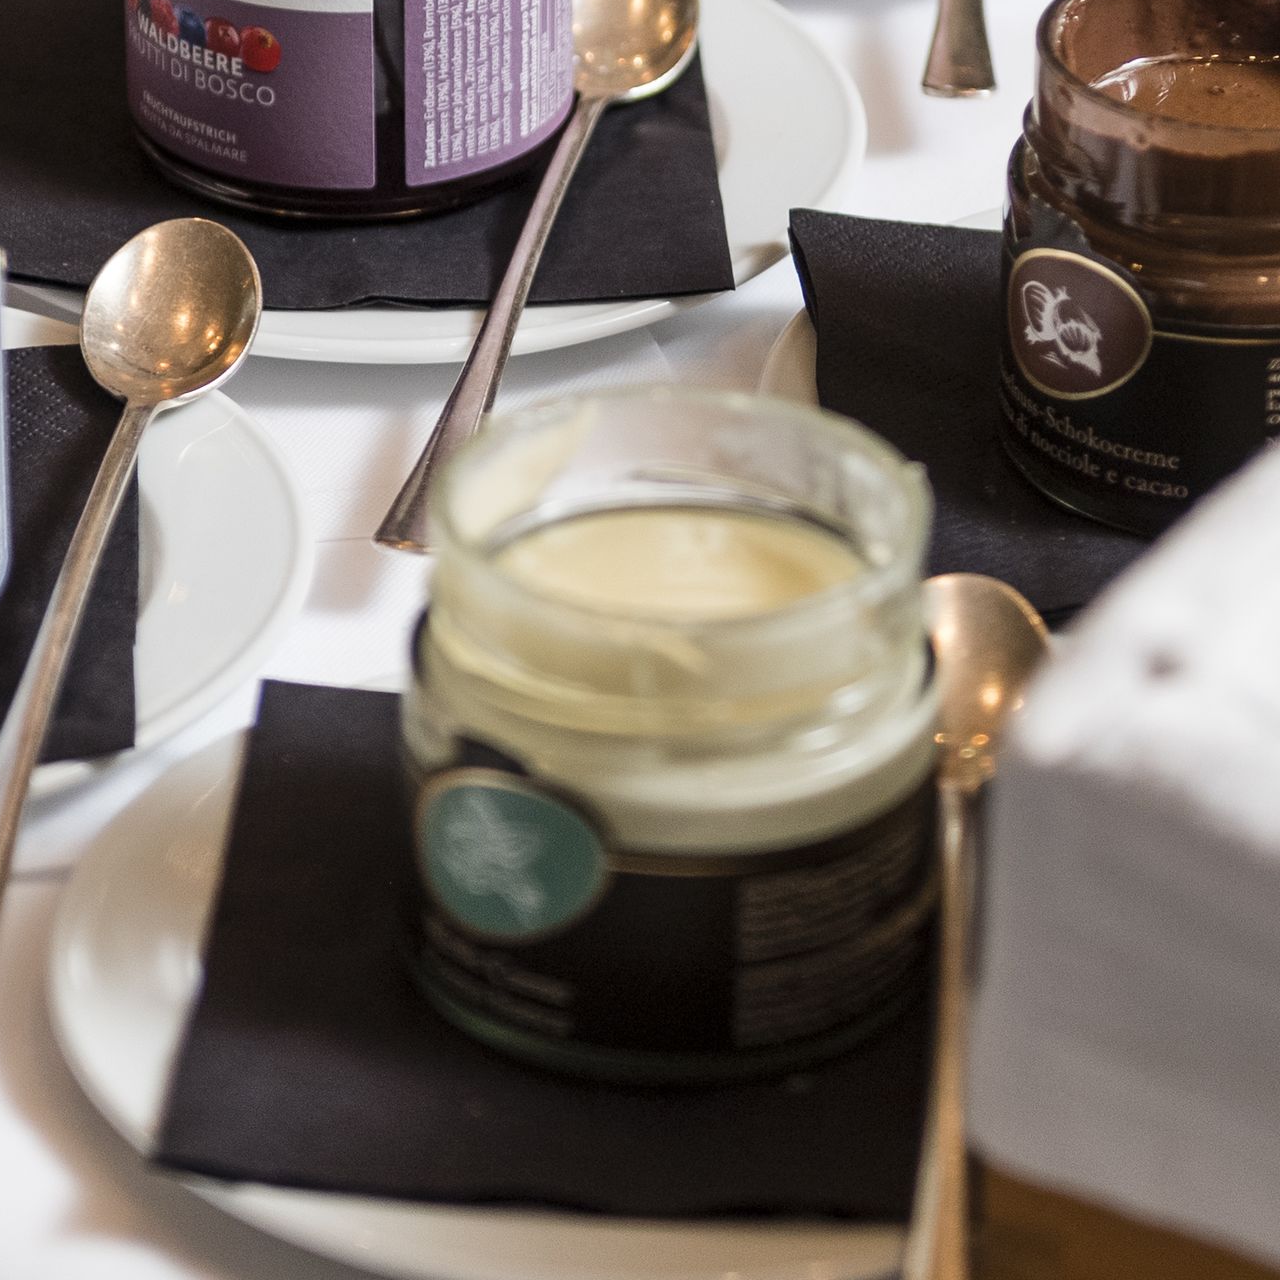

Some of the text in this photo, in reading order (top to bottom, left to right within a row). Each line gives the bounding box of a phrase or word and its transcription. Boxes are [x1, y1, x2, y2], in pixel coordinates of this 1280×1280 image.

[451, 2, 464, 29] (5%),
[477, 14, 489, 60] lampone
[138, 9, 243, 77] WALDBEERE
[422, 40, 436, 70] (13%),
[437, 15, 449, 79] Heidelbeere
[464, 14, 475, 81] Zitronensaft.
[491, 46, 500, 75] rosso
[170, 58, 188, 82] DI
[194, 68, 275, 107] BOSCO
[452, 30, 463, 105] Johannisbeere
[423, 72, 435, 120] Erdbeere
[452, 107, 462, 128] rote
[480, 93, 488, 121] mora
[490, 76, 500, 115] mirtillo
[424, 121, 435, 168] Zutaten:
[438, 112, 449, 163] Himbeere
[1030, 431, 1100, 477] nocciole
[1105, 469, 1118, 483] e
[1124, 475, 1189, 498] cacao
